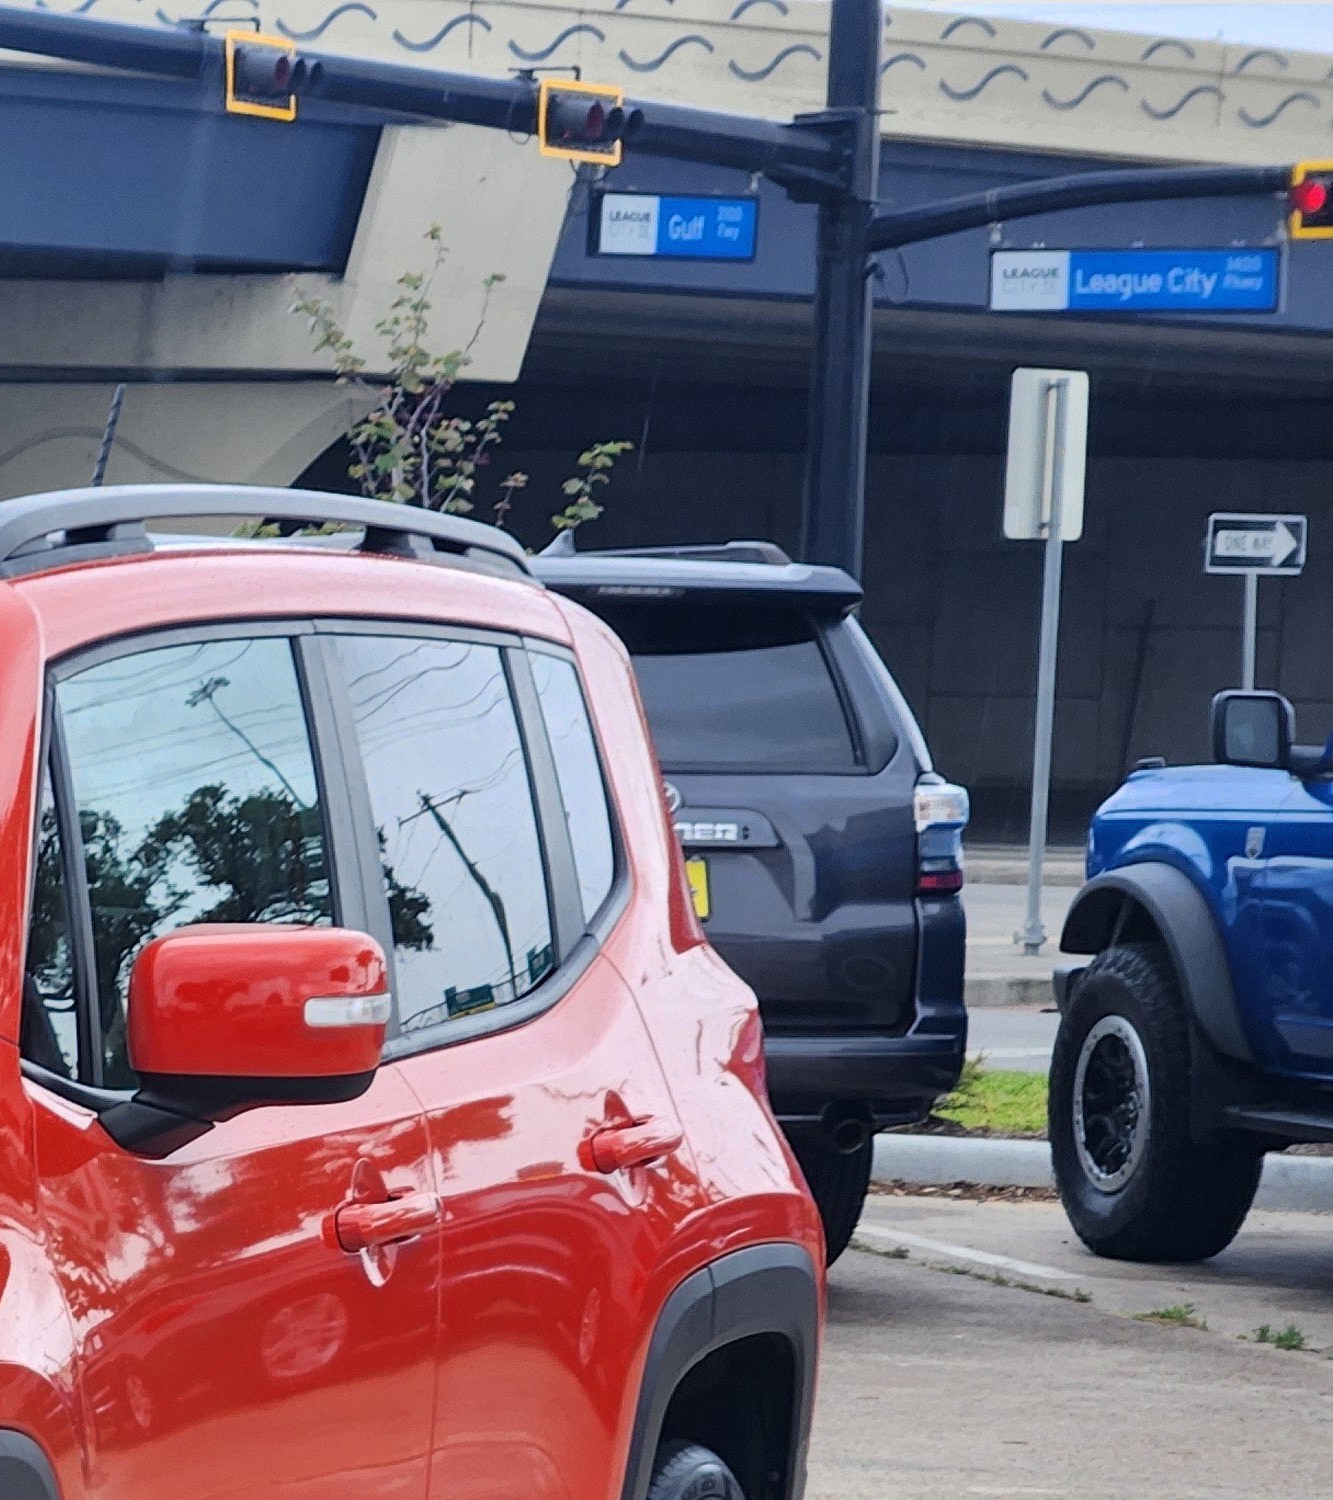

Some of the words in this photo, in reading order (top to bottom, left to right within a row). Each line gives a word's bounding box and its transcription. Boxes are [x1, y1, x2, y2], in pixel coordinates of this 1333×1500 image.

[608, 210, 652, 223] LEAGUE
[1002, 267, 1059, 279] LEAGUE
[1074, 268, 1162, 300] League
[1166, 266, 1218, 299] City
